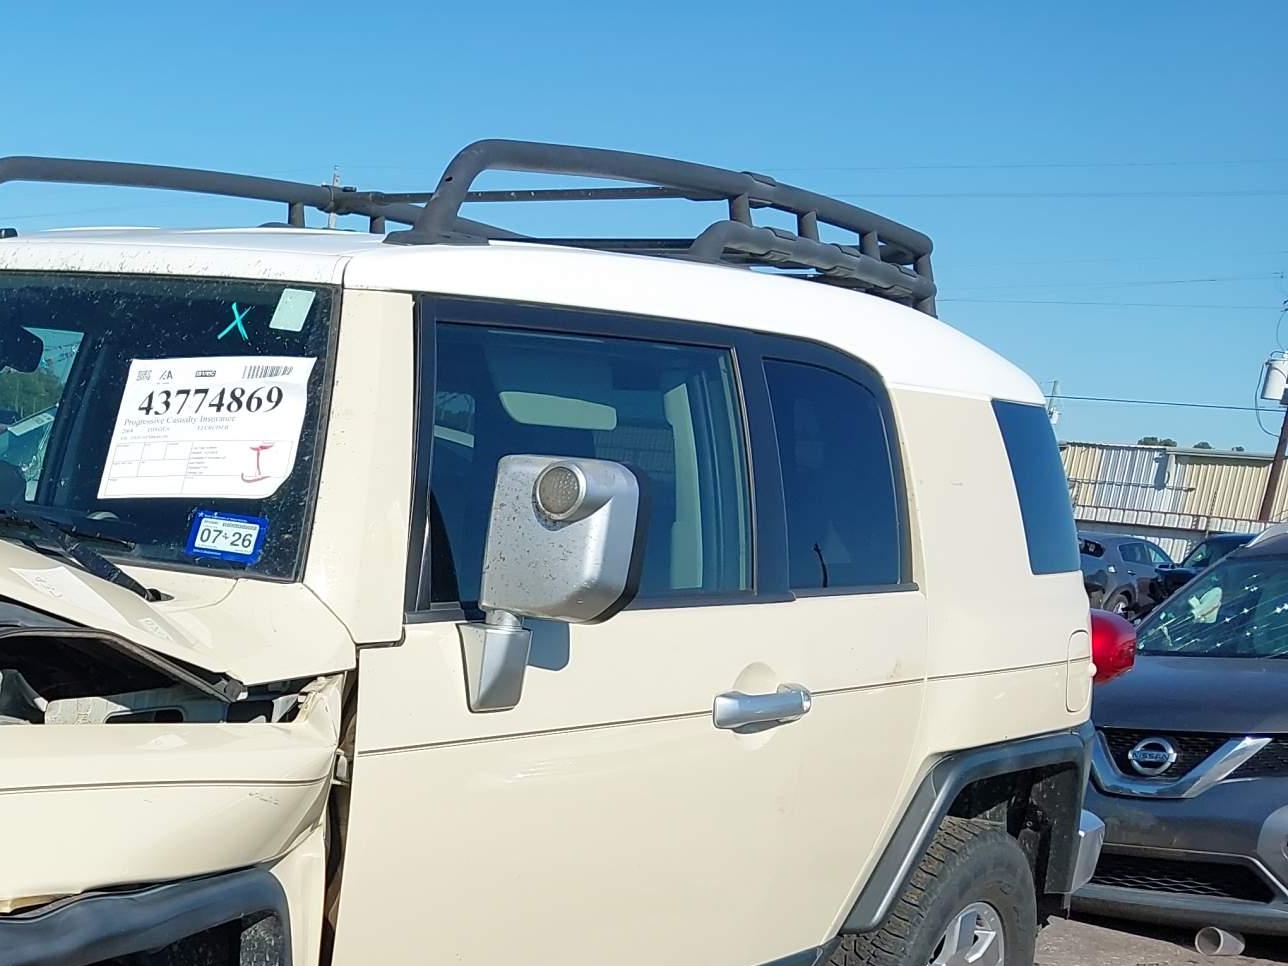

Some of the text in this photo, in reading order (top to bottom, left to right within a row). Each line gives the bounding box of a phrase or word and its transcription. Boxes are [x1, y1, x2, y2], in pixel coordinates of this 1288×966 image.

[138, 386, 284, 415] 43774869
[124, 415, 236, 427] Progressive Casualty Insurance
[200, 528, 253, 549] 07 26
[1132, 751, 1169, 762] NISSAN
